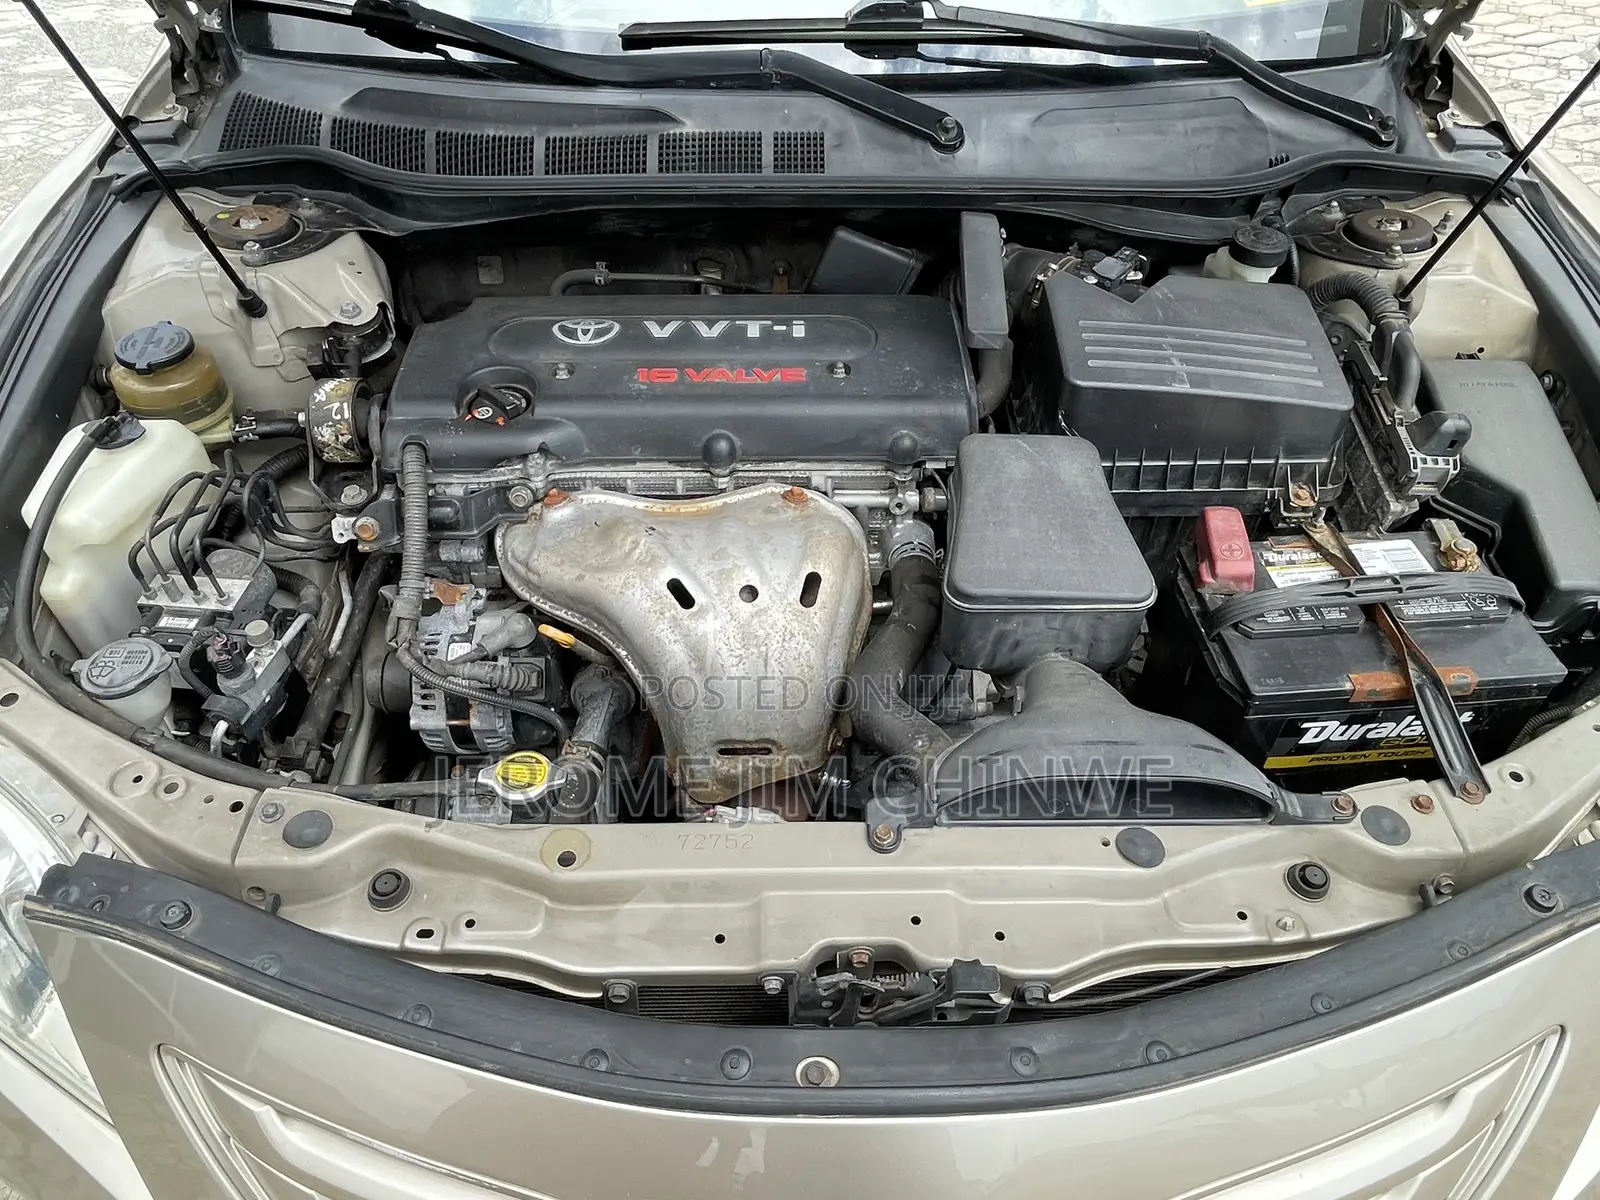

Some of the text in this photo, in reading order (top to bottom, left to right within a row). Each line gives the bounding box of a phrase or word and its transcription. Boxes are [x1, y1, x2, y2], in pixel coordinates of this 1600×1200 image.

[642, 320, 806, 338] VVT-i
[637, 367, 807, 383] 16 VALVE
[1298, 710, 1476, 745] Duralat
[1380, 736, 1429, 747] GOL
[1308, 749, 1428, 764] PROVEN TOUGH
[677, 833, 755, 850] 72752
